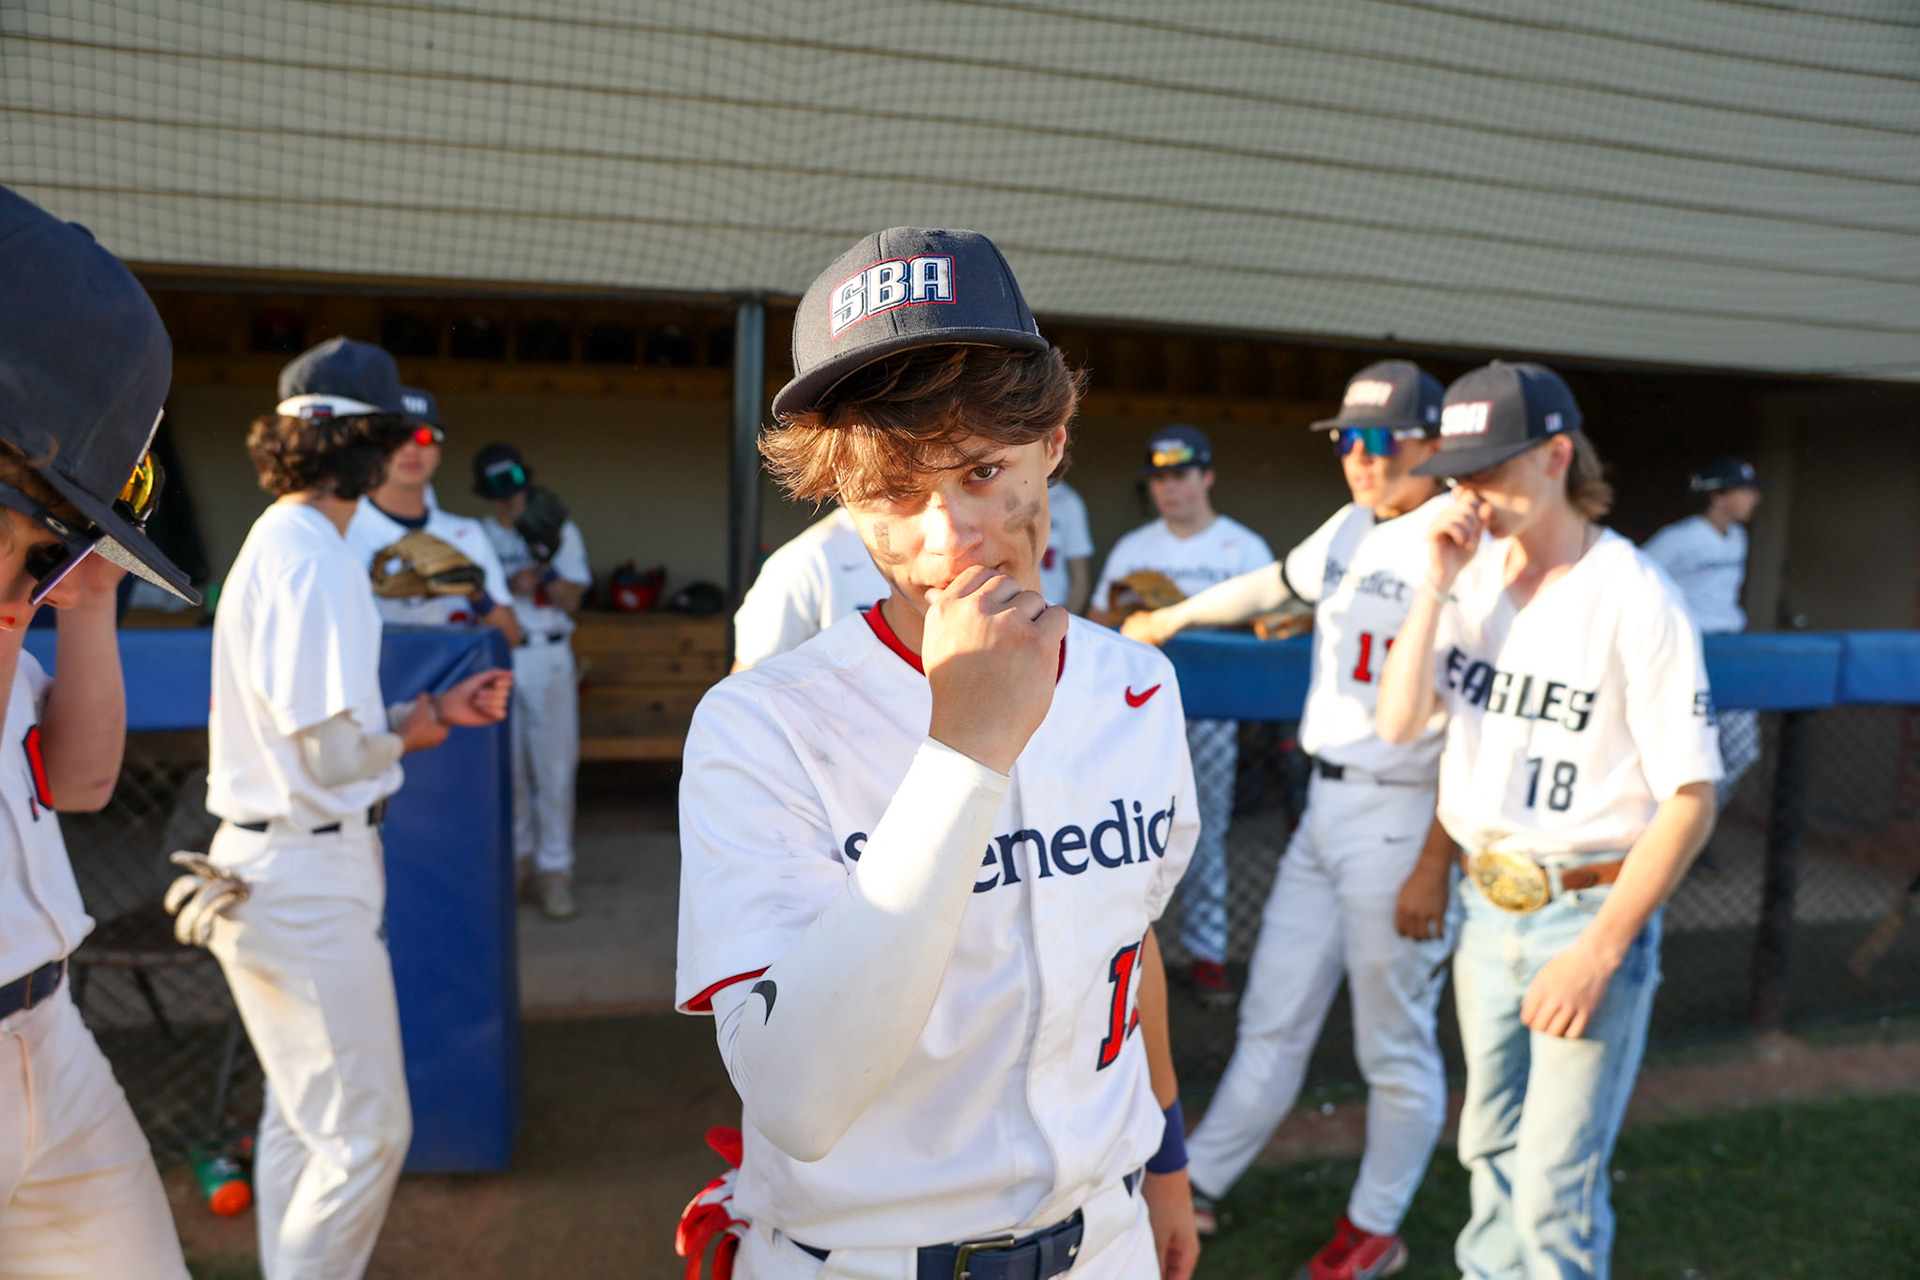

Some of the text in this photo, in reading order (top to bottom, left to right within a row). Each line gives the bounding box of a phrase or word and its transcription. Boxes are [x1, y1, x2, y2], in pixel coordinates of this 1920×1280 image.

[829, 253, 957, 343] SBA
[1353, 630, 1397, 684] 1
[1445, 646, 1597, 733] EAGLES
[1524, 755, 1579, 813] 18
[1095, 926, 1150, 1072] 1
